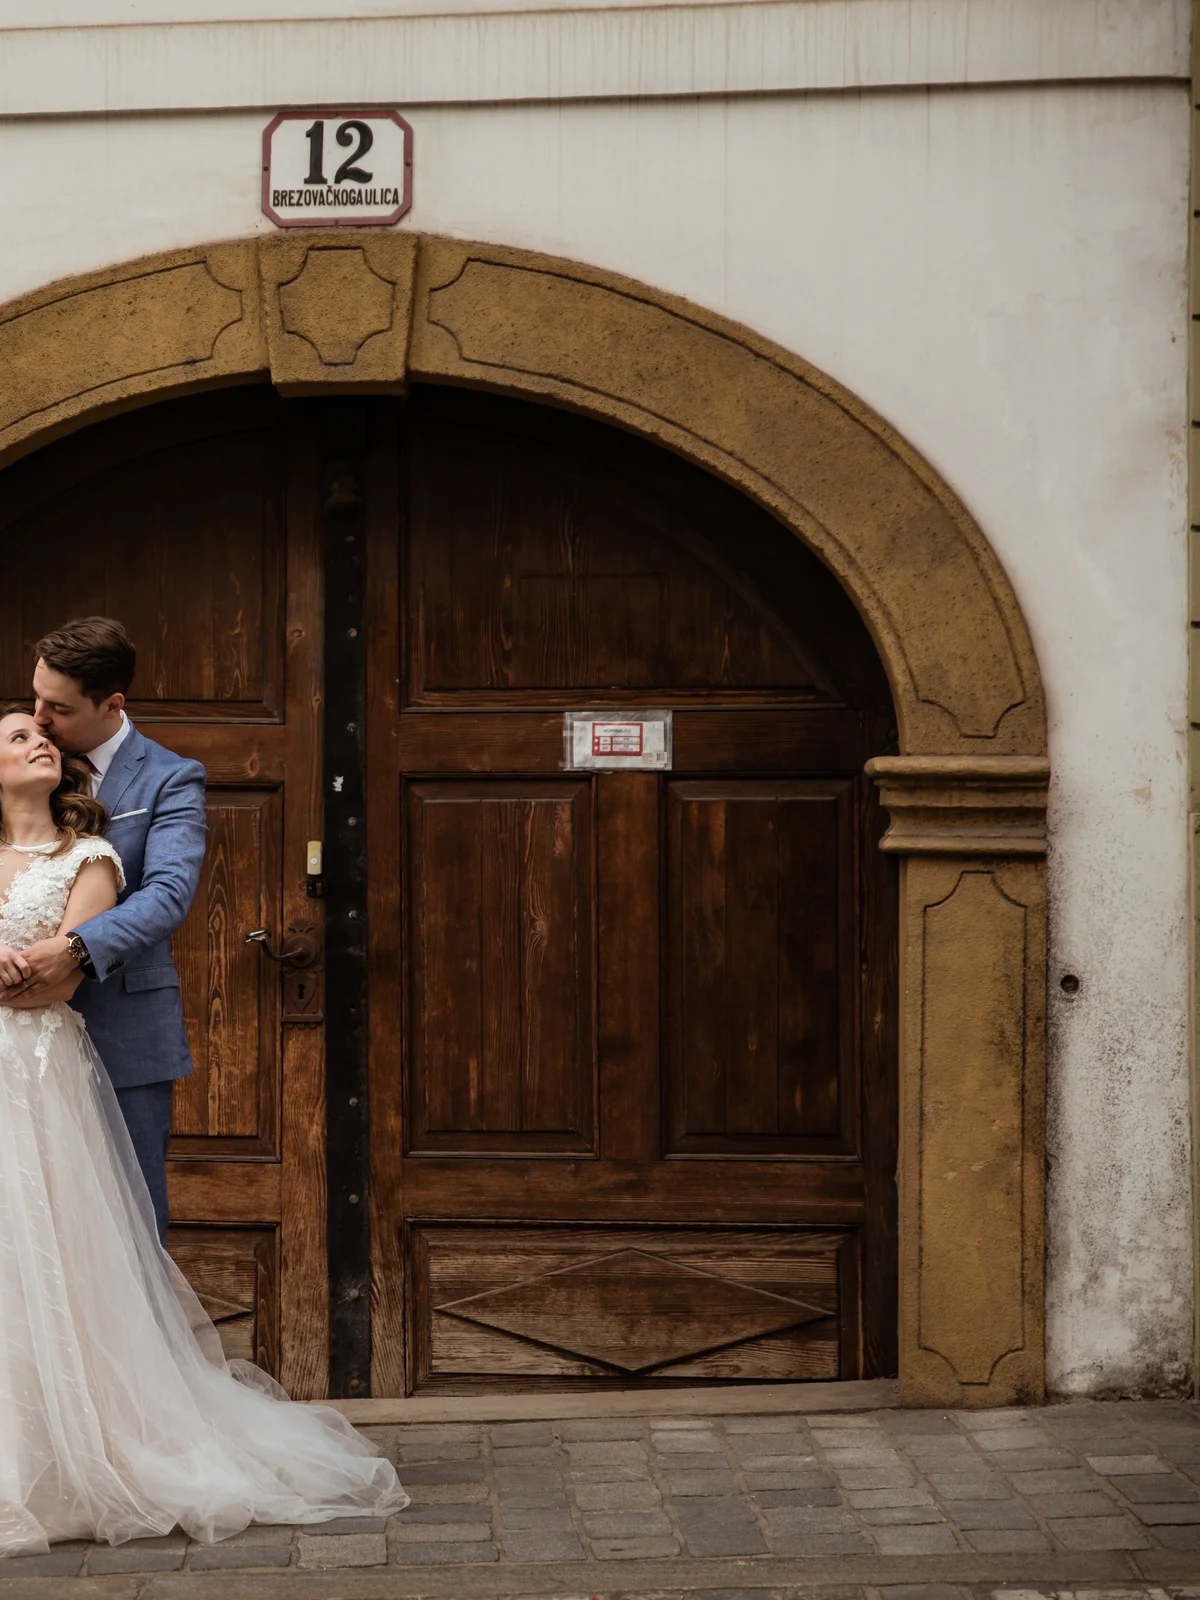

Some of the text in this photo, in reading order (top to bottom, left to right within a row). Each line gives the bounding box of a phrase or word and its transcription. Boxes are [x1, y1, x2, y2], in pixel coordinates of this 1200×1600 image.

[303, 120, 374, 184] 12
[272, 185, 400, 207] BREZOVAČKOGA ULICA
